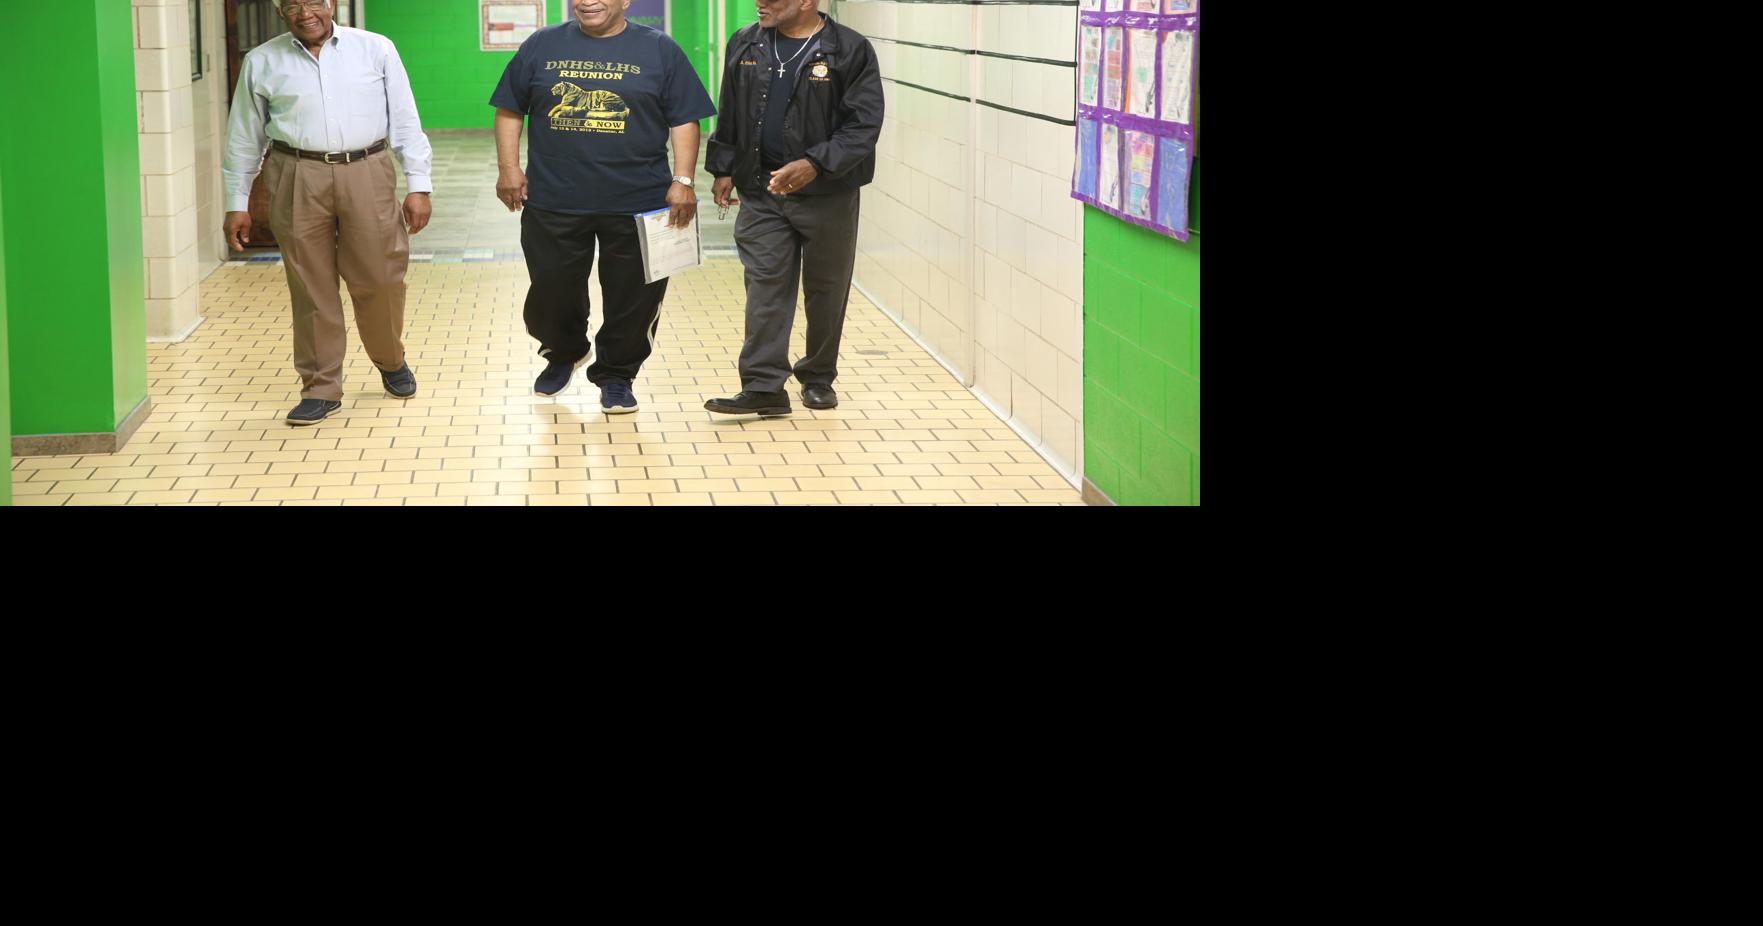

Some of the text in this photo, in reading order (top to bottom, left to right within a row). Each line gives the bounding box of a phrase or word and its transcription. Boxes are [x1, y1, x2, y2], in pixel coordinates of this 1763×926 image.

[558, 70, 623, 80] REUNION
[553, 118, 580, 126] THEN
[596, 121, 622, 129] NOW
